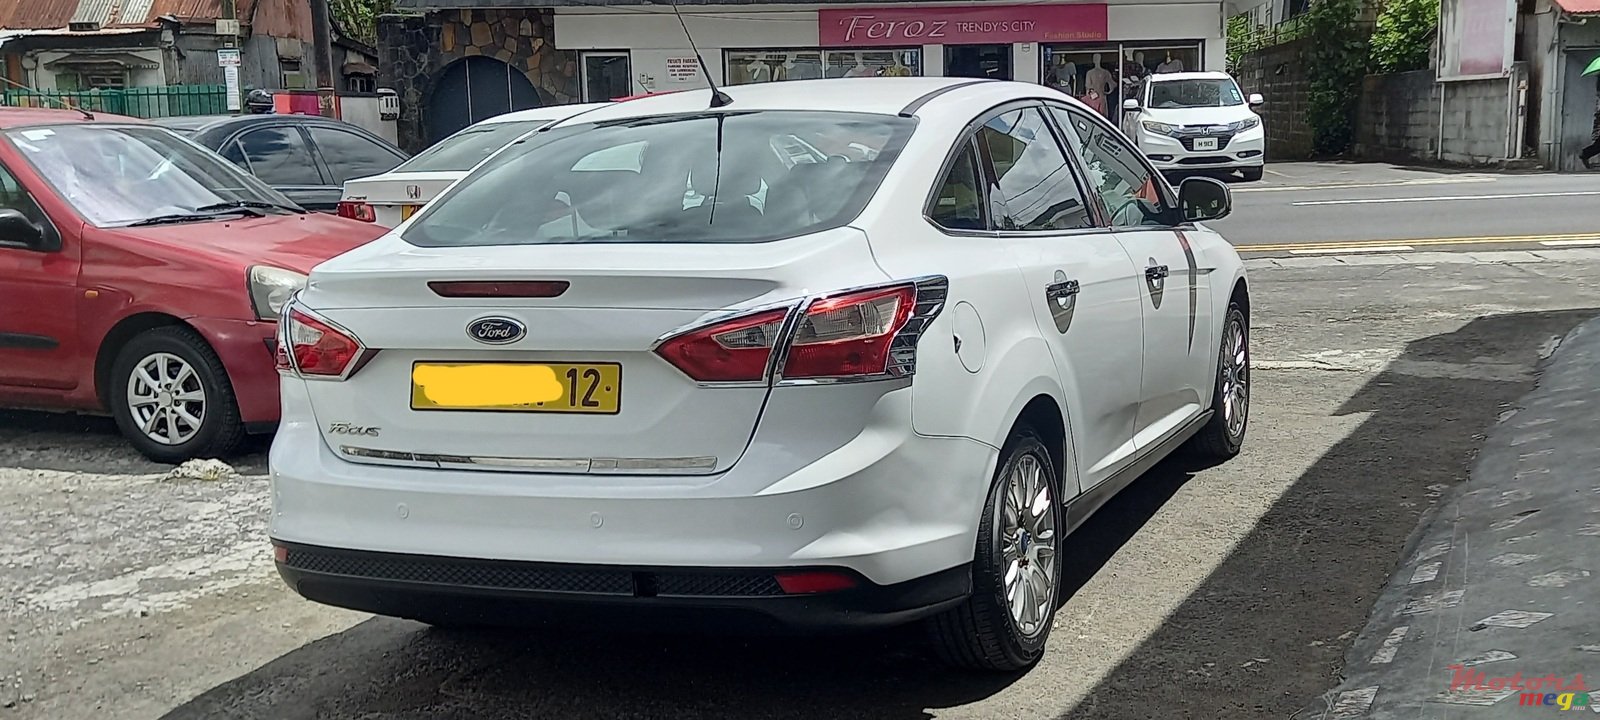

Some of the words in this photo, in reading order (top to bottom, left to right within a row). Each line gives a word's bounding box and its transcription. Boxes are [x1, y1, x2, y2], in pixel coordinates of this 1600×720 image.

[839, 15, 949, 41] Feroz
[956, 22, 1008, 33] TRENDY'S
[1011, 21, 1037, 32] CITY
[1076, 31, 1102, 39] Studio
[478, 322, 511, 338] Ford
[566, 368, 601, 407] 12
